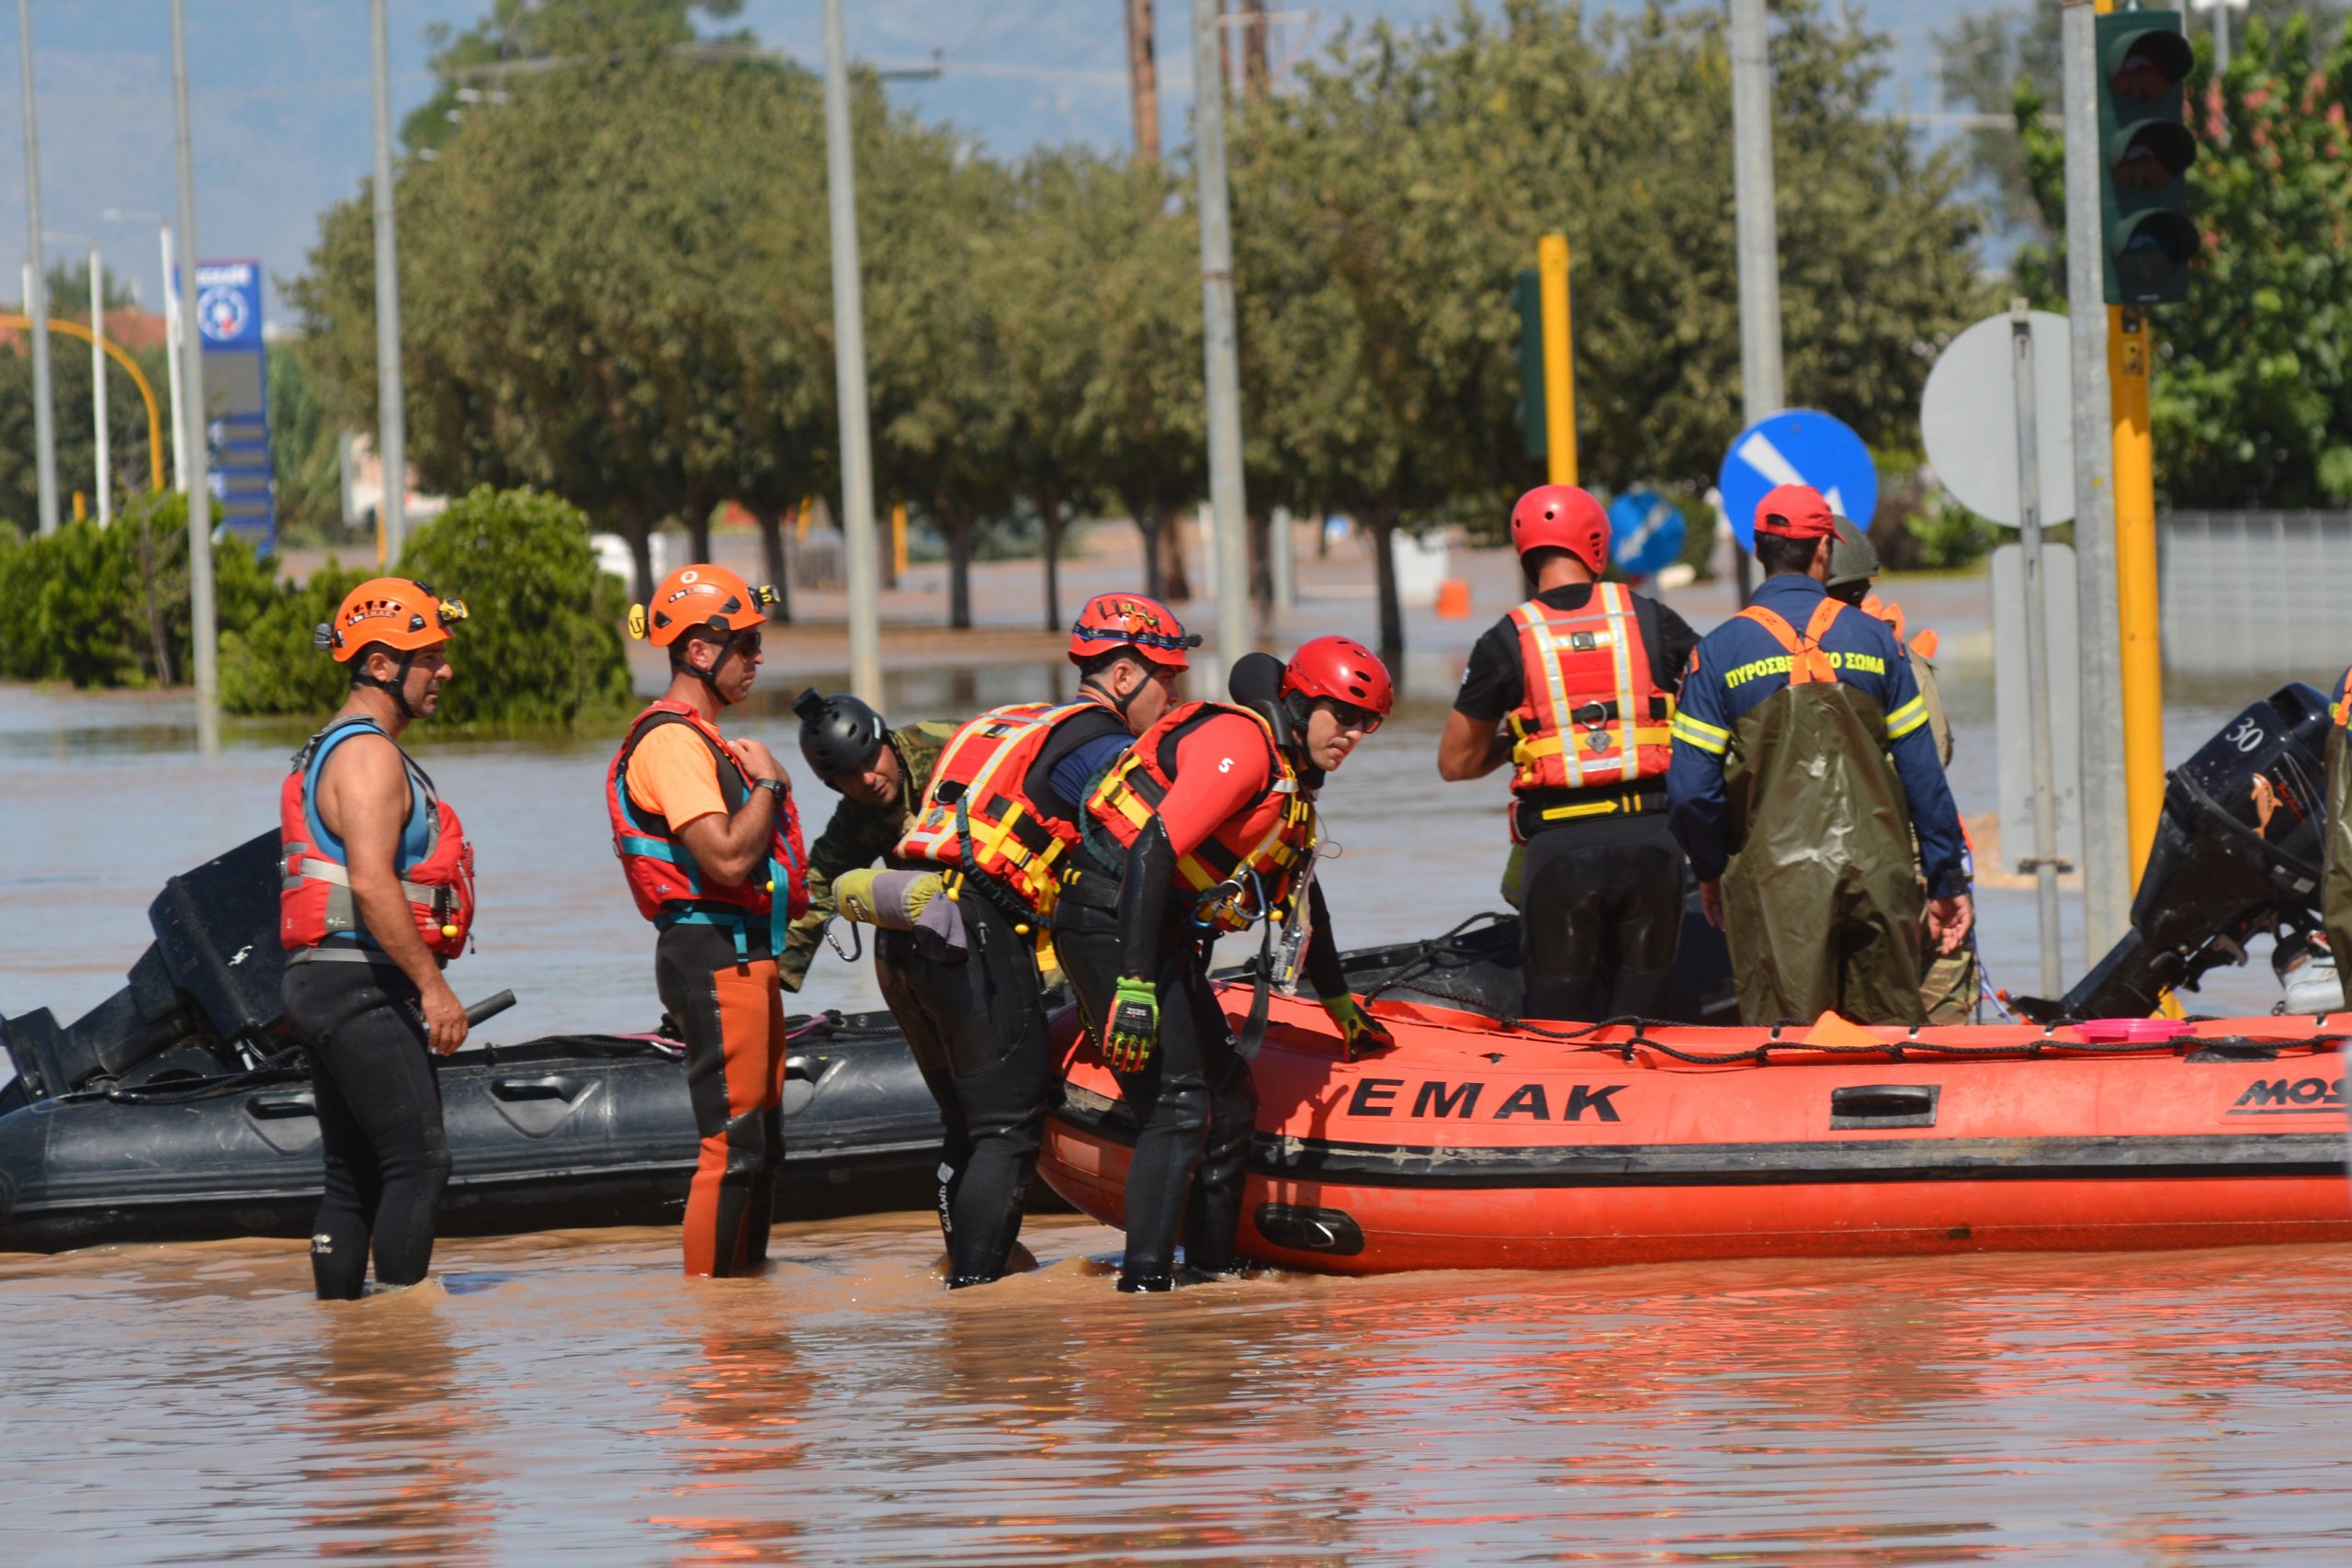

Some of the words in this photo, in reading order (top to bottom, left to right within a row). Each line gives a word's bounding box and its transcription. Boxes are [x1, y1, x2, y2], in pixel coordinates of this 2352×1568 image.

[1724, 651, 1842, 689] ΠΥΡΟΣΒΕΟ
[1845, 651, 1885, 676] ΣΩΜΑ
[2225, 717, 2264, 752] 30
